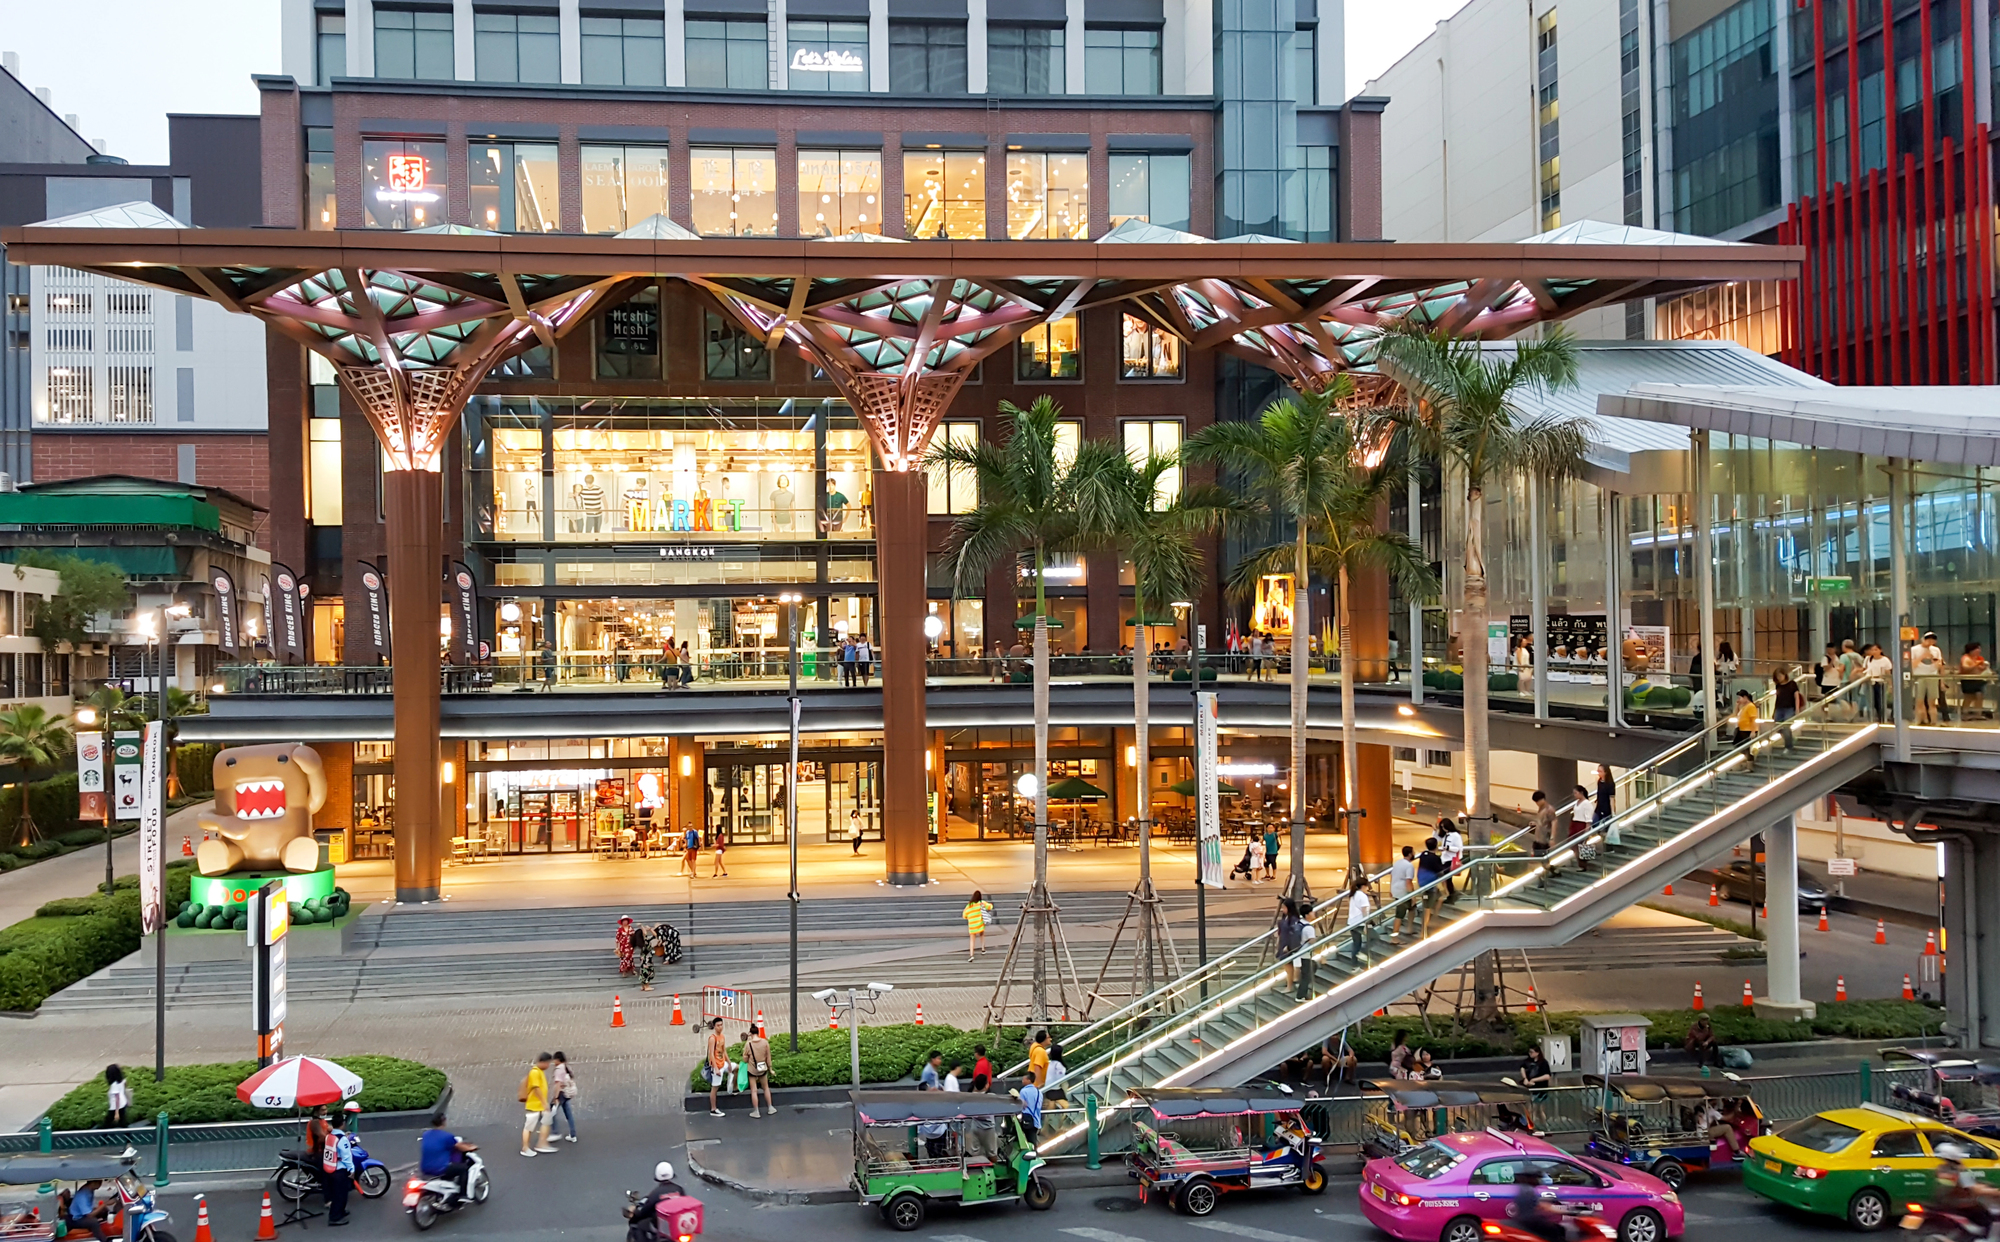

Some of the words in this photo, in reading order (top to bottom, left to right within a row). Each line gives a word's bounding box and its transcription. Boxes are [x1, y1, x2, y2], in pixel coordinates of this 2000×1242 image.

[585, 175, 667, 187] SEAOOD
[613, 323, 648, 335] Moshi
[628, 499, 745, 531] MARKET
[660, 547, 715, 556] BANGKOK
